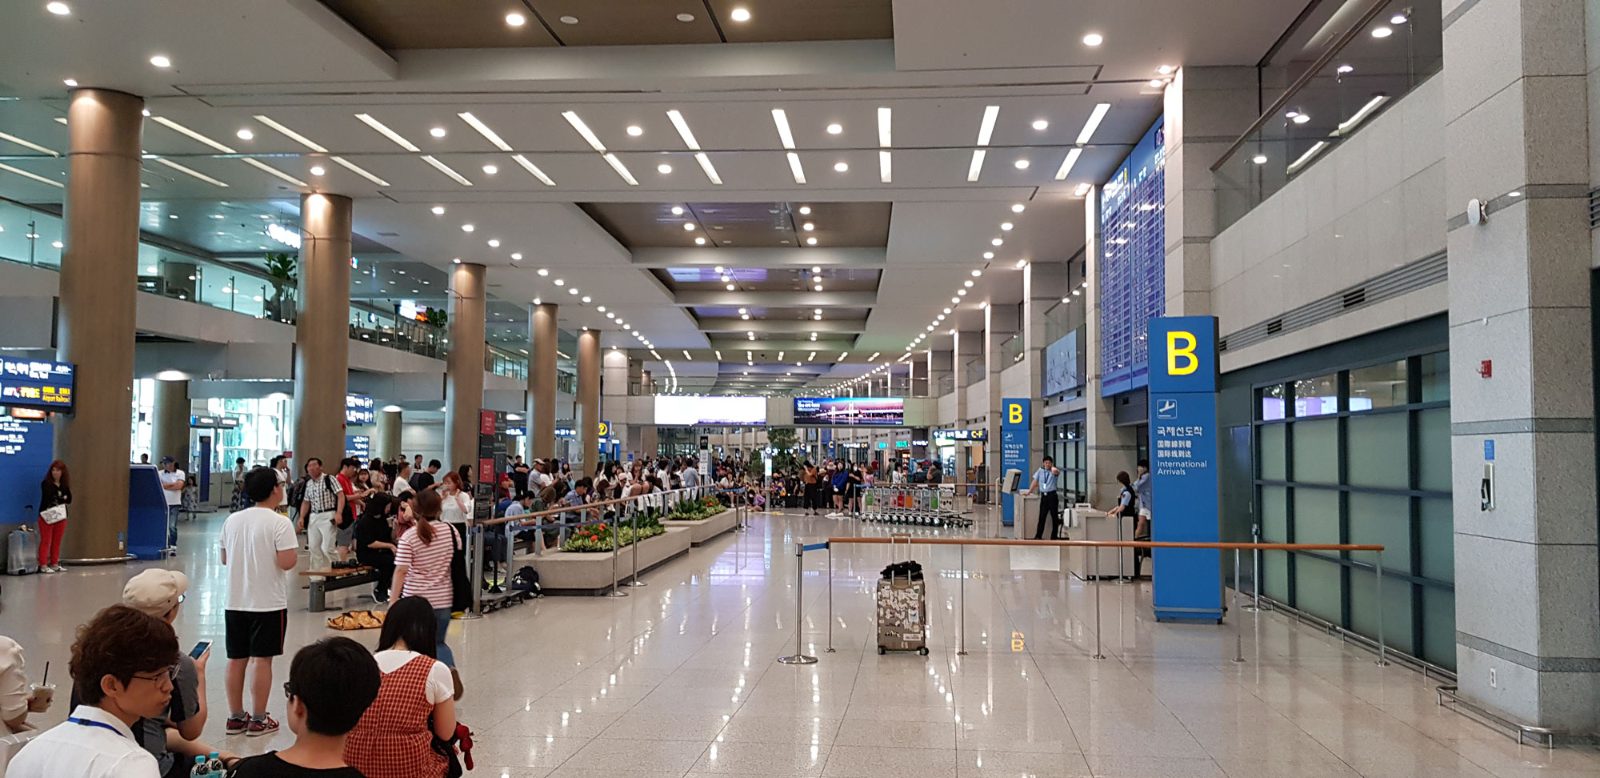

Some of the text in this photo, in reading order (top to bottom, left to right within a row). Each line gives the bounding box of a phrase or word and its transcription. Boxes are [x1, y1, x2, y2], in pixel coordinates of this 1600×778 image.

[1167, 331, 1199, 375] B
[1009, 403, 1023, 424] B
[1157, 426, 1203, 437] 국제선도착
[1157, 460, 1208, 468] International
